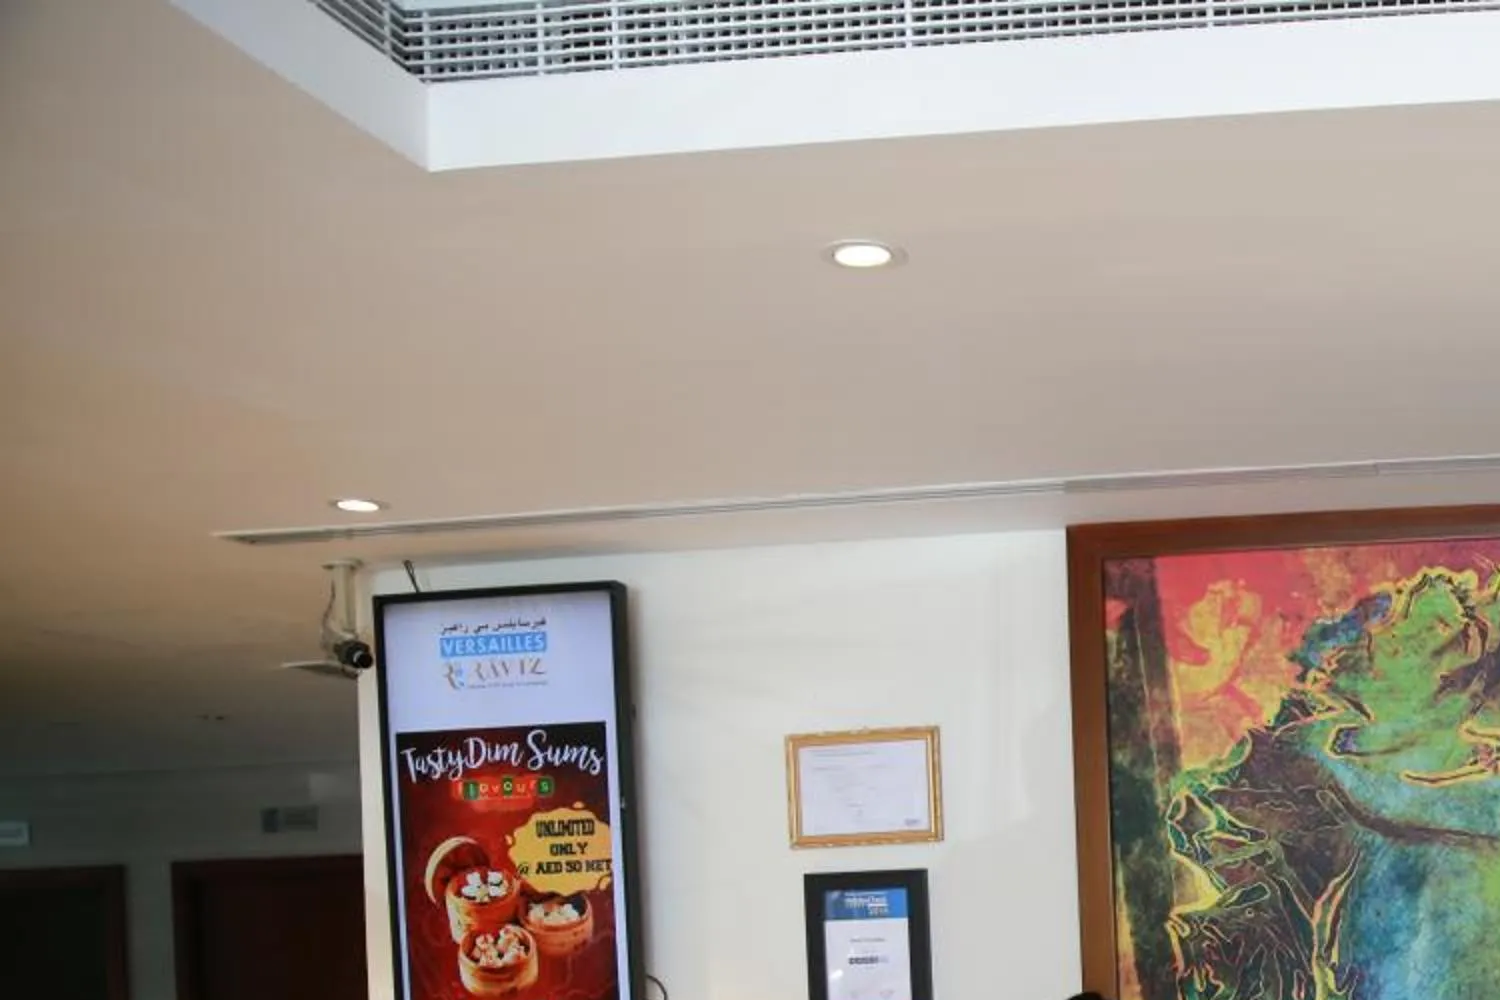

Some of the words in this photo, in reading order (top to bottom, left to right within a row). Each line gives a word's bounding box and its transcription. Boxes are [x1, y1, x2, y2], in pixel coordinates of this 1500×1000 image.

[442, 633, 546, 655] VERSAILLES
[400, 747, 465, 783] Tasty
[463, 737, 525, 769] Dim
[527, 729, 604, 775] Sums
[535, 819, 595, 837] UNLIMITED
[550, 842, 588, 856] ONLY
[536, 861, 562, 875] AED
